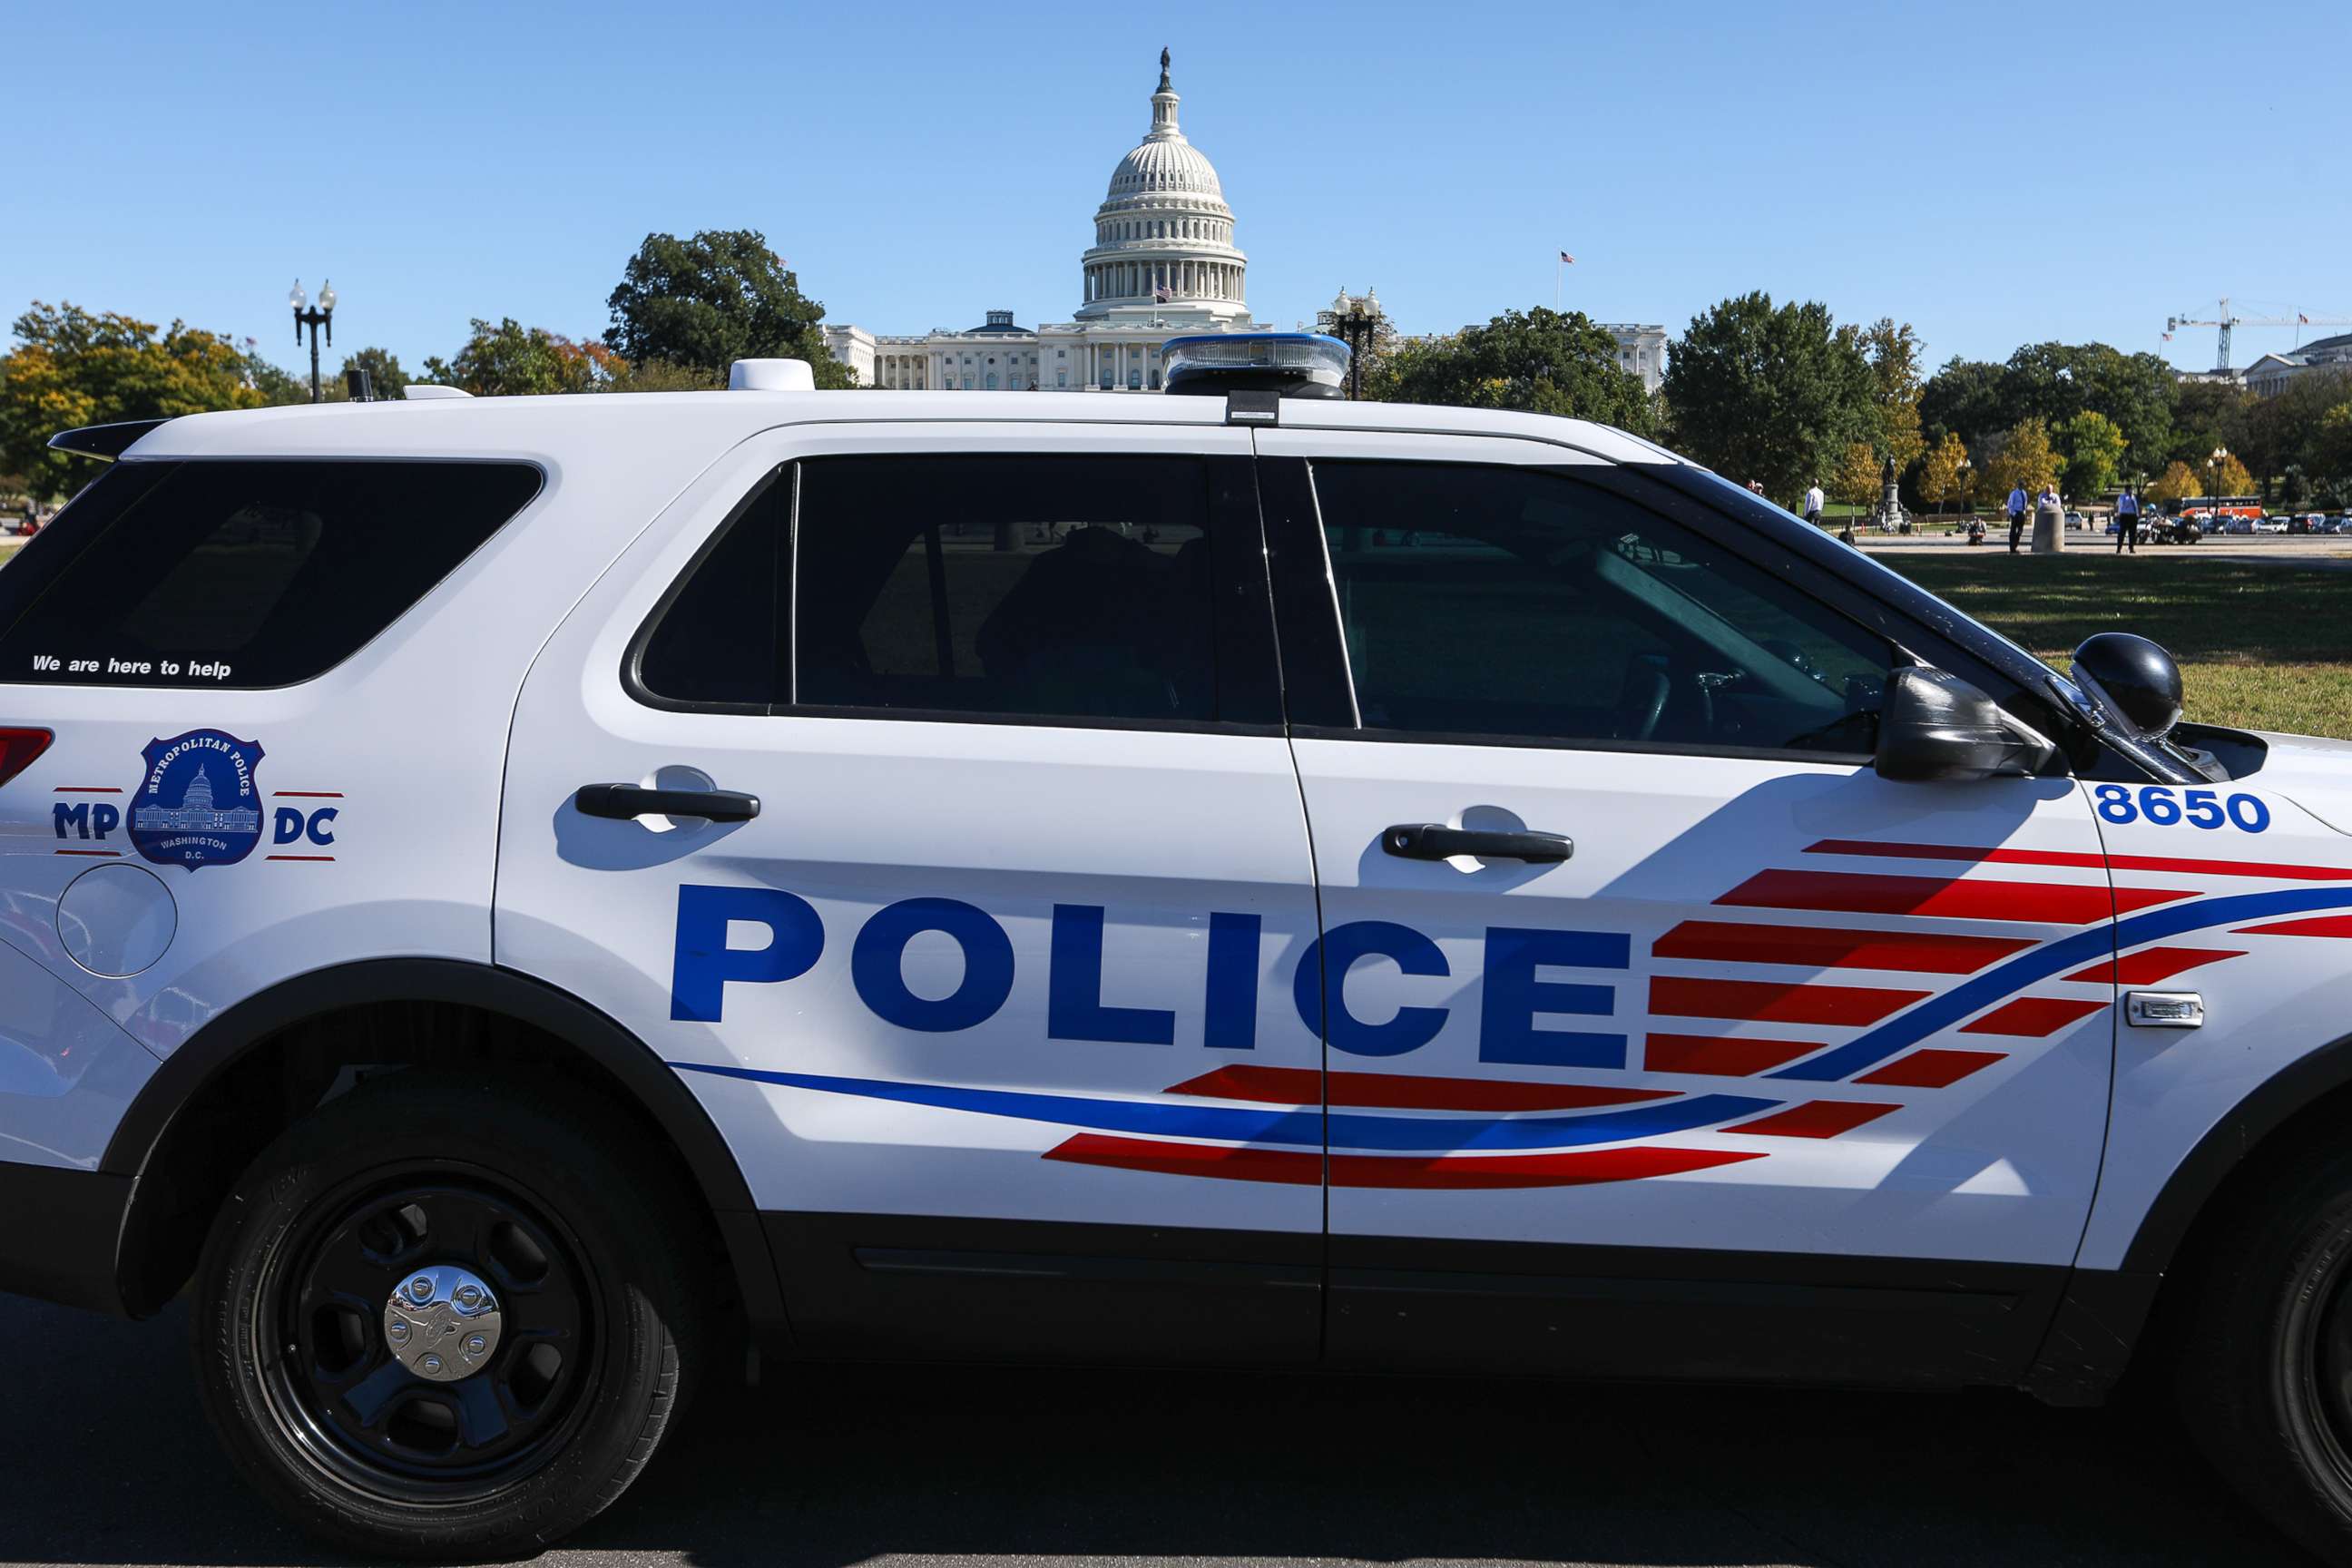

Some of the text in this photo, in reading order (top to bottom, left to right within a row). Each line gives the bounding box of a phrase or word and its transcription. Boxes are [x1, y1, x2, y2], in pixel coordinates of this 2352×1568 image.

[33, 655, 231, 680] We are here to help
[148, 737, 250, 797] METROPOLITAN POLICE
[53, 802, 121, 840] MP
[272, 806, 340, 847] DC
[2094, 784, 2270, 834] 8650
[160, 836, 228, 850] WASHINGTON
[184, 850, 204, 859] D.C.
[670, 883, 1632, 1071] POLICE
